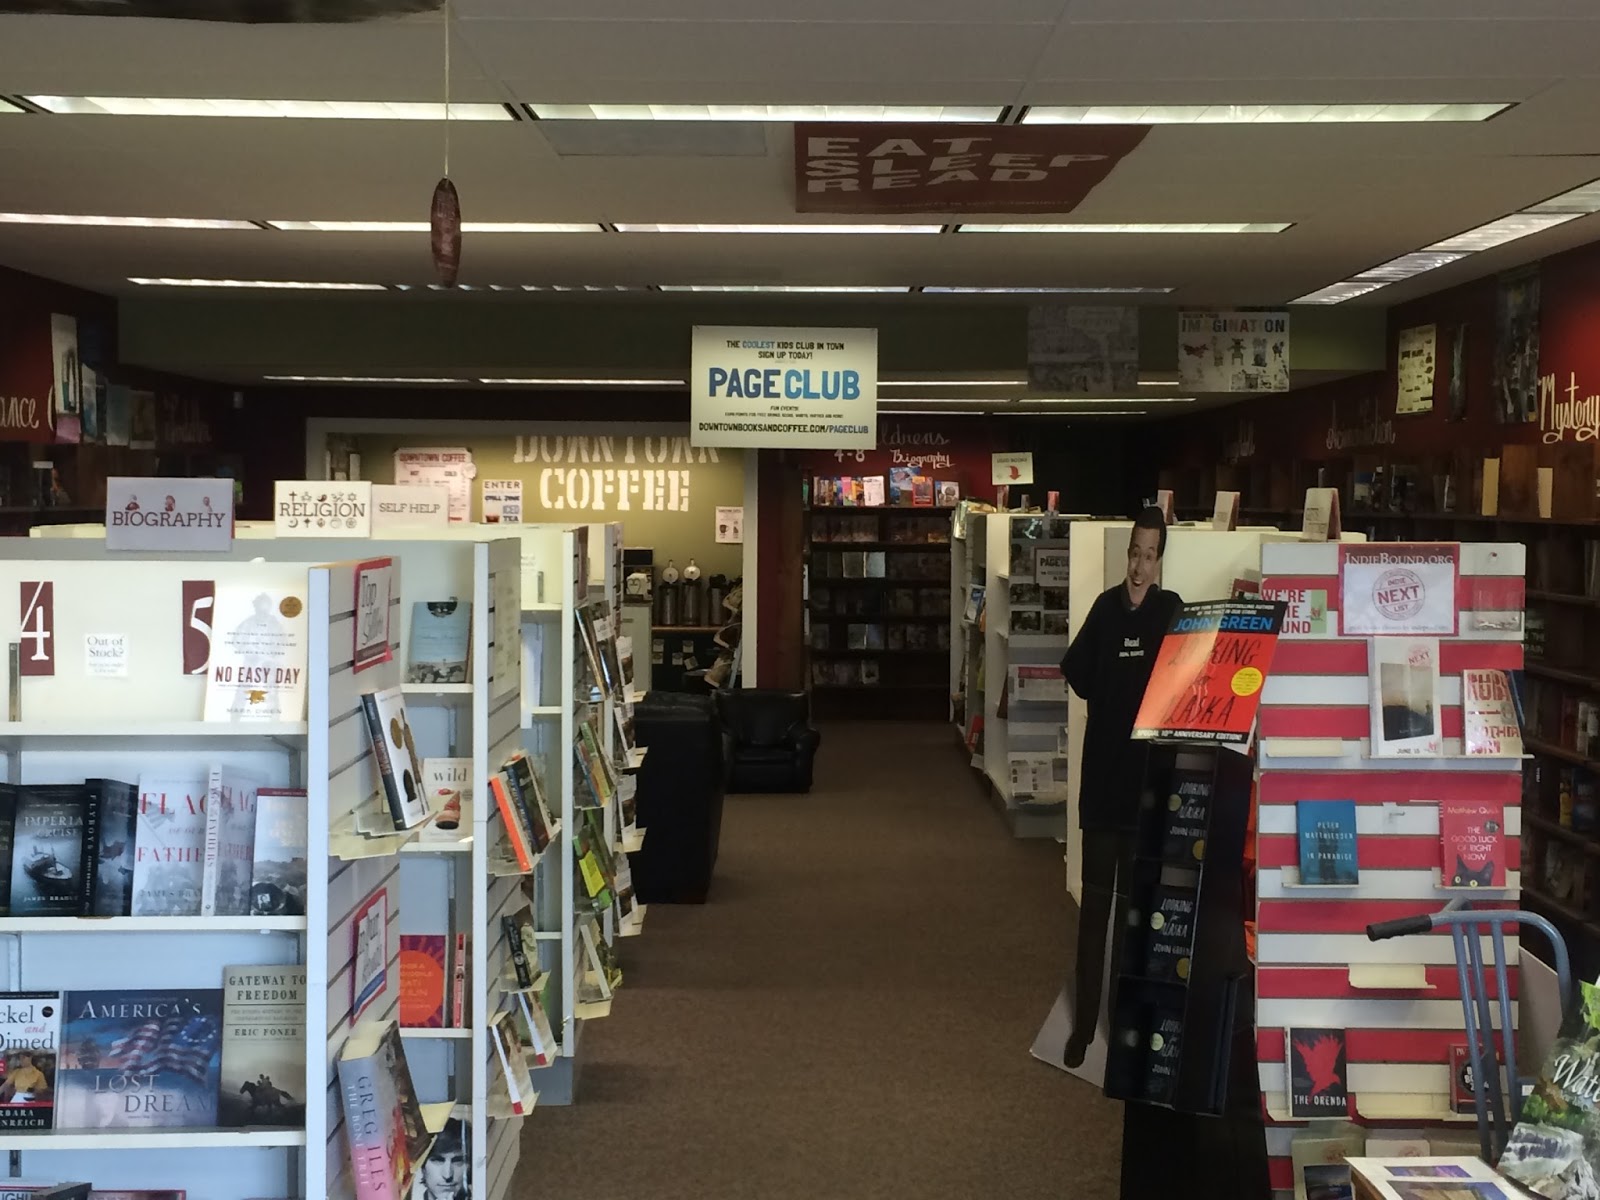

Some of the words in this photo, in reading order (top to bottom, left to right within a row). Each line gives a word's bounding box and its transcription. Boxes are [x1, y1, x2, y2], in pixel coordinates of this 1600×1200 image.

[807, 137, 992, 157] EAT
[805, 153, 1110, 177] SLEEP
[807, 169, 1049, 193] READ
[726, 340, 740, 348] THE
[742, 341, 775, 349] COOLEST
[777, 341, 793, 350] KIDS
[795, 342, 814, 350] CLUB
[816, 342, 825, 350] IN
[826, 342, 844, 351] TOWN
[758, 351, 775, 359] SIGN
[776, 351, 787, 359] UP
[788, 352, 813, 360] TODAY!
[1537, 371, 1600, 444] Mystery
[441, 453, 466, 462] COFFEE
[890, 449, 956, 470] Biography
[484, 481, 520, 489] ENTER
[540, 468, 690, 512] COFFEE
[279, 502, 366, 518] RELIGION
[379, 503, 408, 514] SELF
[409, 504, 441, 514] HELP
[112, 510, 226, 528] BIOGRAPHY
[1261, 589, 1306, 603] WE'RE
[1377, 585, 1420, 605] NEXT
[1393, 604, 1409, 613] LIST
[20, 581, 51, 661] 4
[1174, 617, 1213, 632] JOHN
[1218, 616, 1274, 631] GREEN
[87, 636, 109, 646] Out
[111, 635, 125, 646] of
[190, 596, 214, 675] 5
[88, 647, 125, 658] Stock?
[1408, 651, 1430, 665] NEXT
[215, 666, 233, 682] NO
[237, 666, 271, 684] EASY
[275, 668, 301, 684] DAY
[1173, 731, 1216, 739] ANNIVERSARY
[433, 767, 467, 782] wild
[1178, 782, 1212, 797] LOOKING
[1447, 806, 1478, 815] Matthew
[1317, 821, 1340, 829] PETER
[1467, 826, 1481, 834] THE
[1478, 835, 1498, 843] LUCK
[1469, 844, 1493, 852] RIGHT
[1463, 853, 1487, 861] NOW
[1160, 898, 1194, 914] LOOKING
[229, 975, 287, 986] GATEWAY
[292, 975, 307, 986] TO
[237, 990, 298, 1001] FREEDOM
[78, 998, 201, 1019] AMERICA'S
[25, 1023, 47, 1034] and
[235, 1028, 258, 1037] ERIC
[263, 1028, 297, 1037] FONER
[94, 1074, 160, 1094] LOST
[358, 1075, 378, 1135] GREG
[1294, 1094, 1309, 1105] THE
[1313, 1095, 1347, 1107] ORENDA
[367, 1145, 387, 1191] ILES
